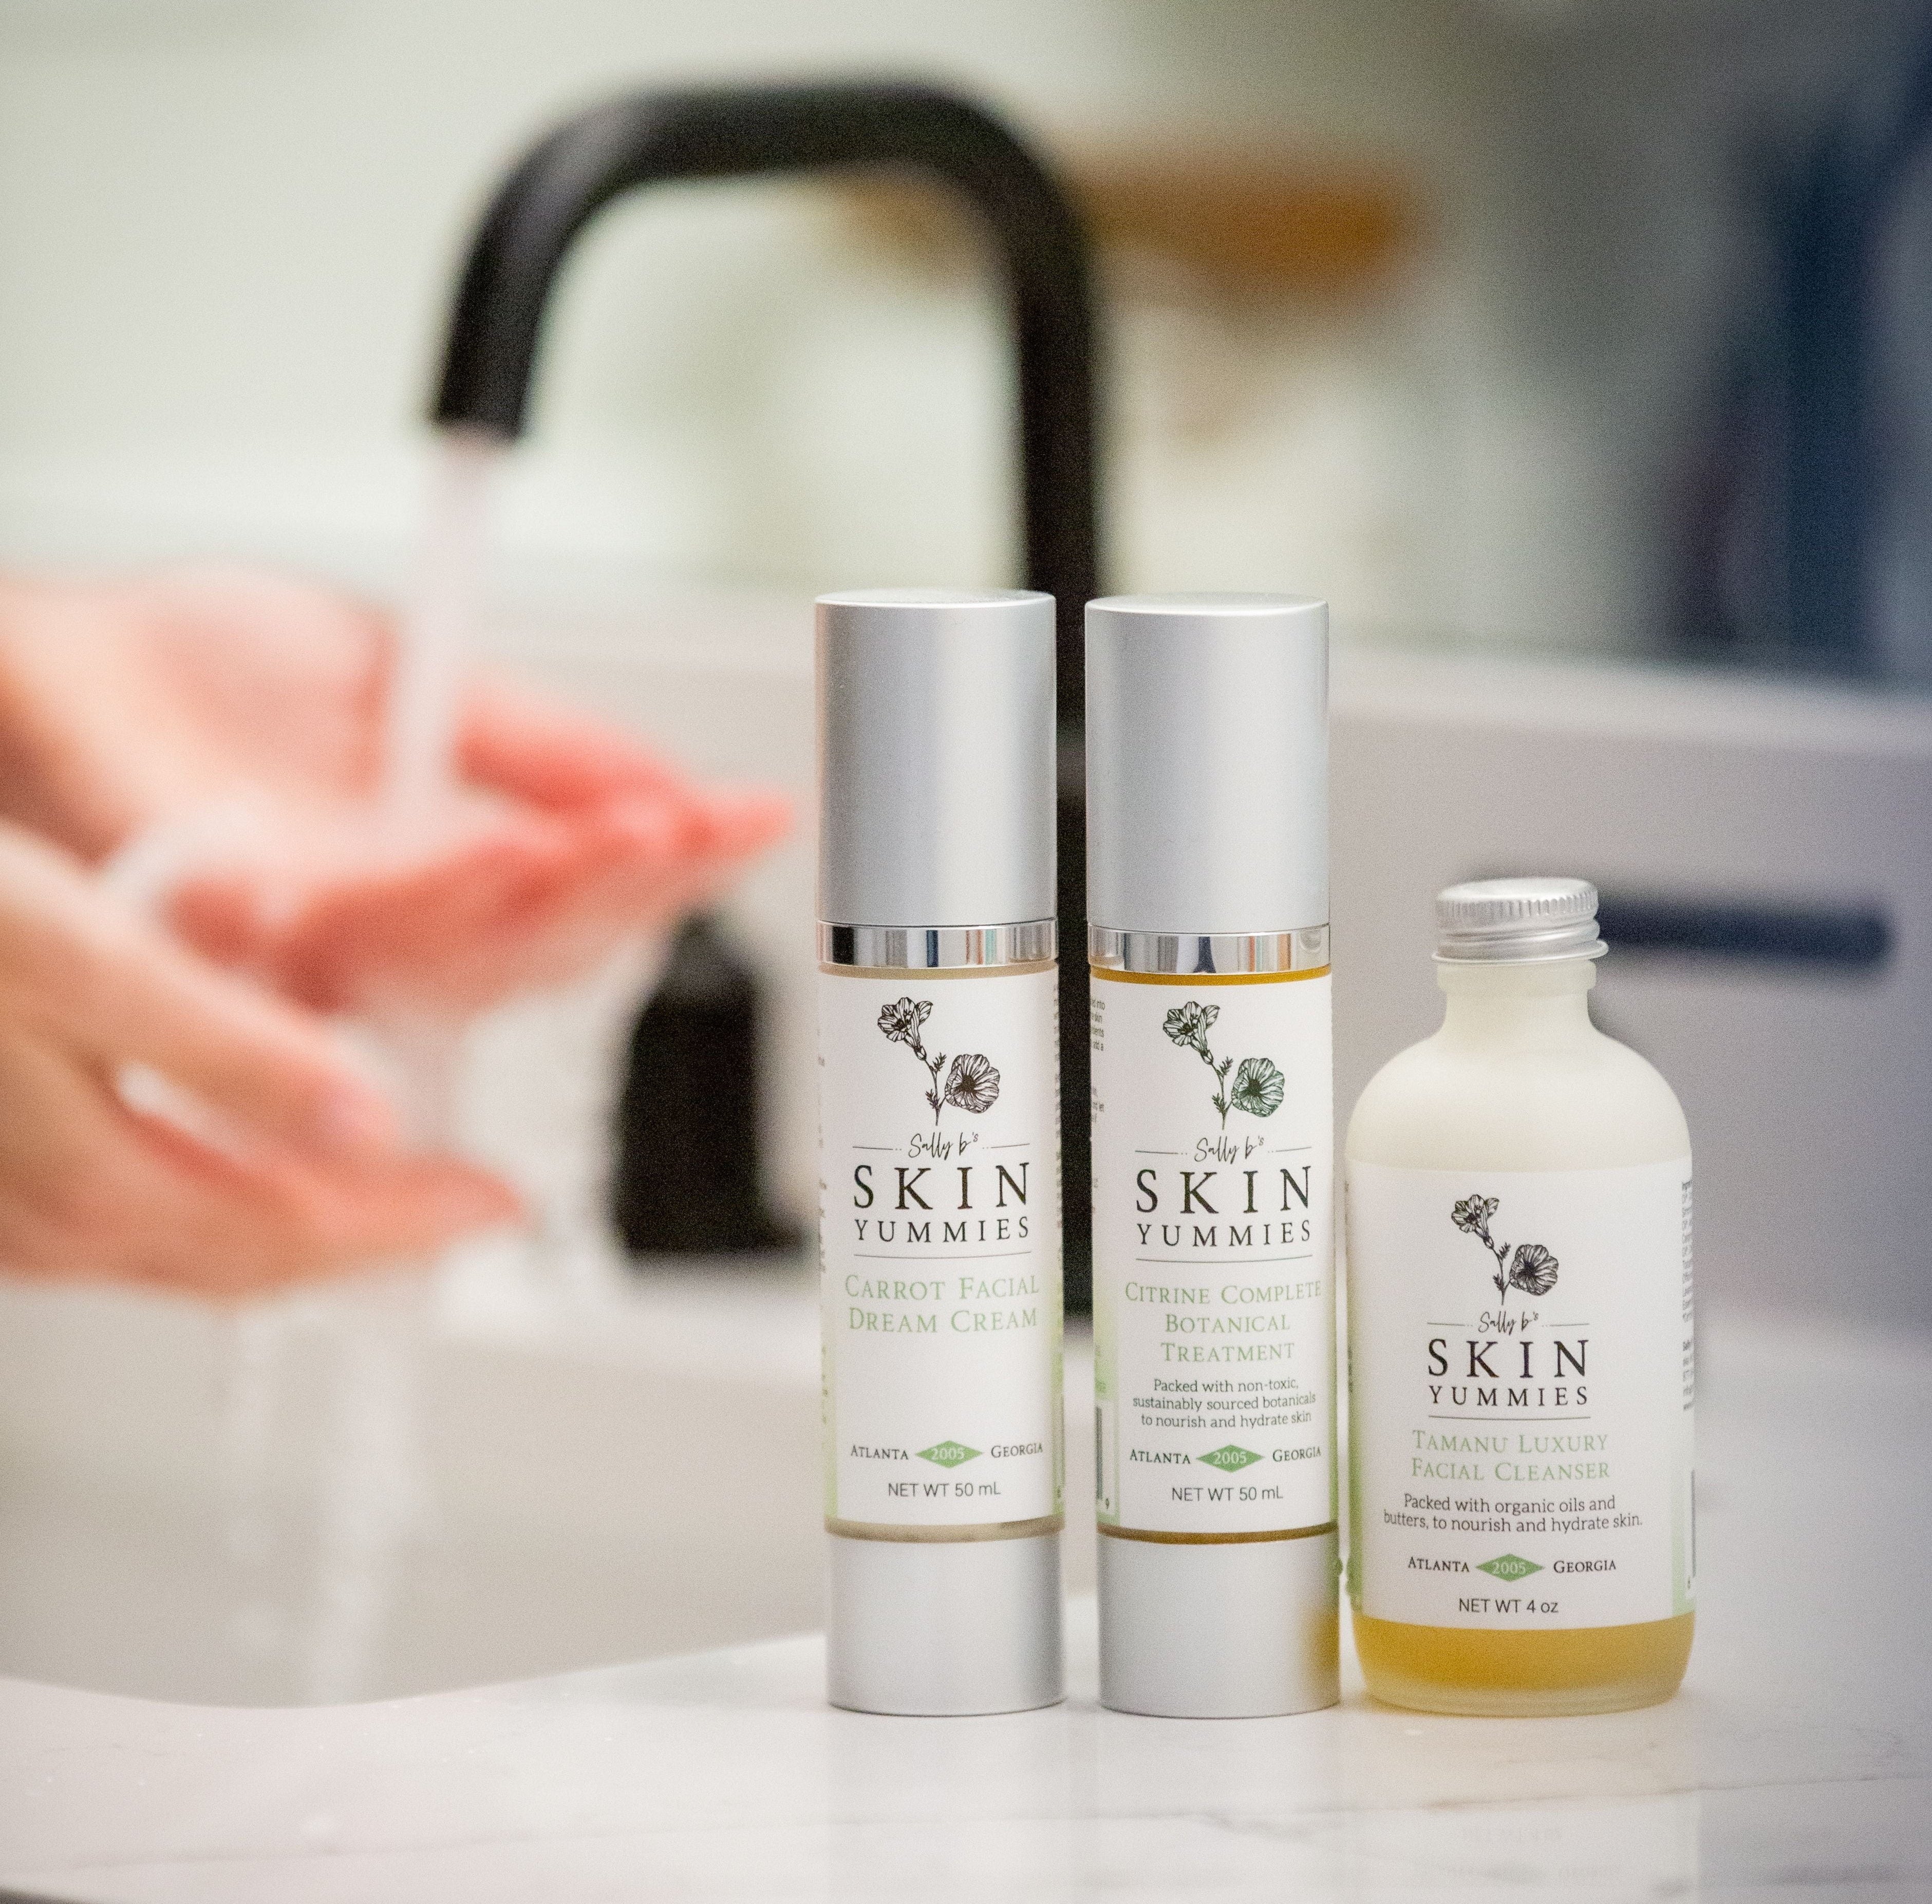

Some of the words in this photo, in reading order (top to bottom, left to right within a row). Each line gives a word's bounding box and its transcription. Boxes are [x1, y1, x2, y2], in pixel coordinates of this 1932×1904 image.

[908, 1132, 952, 1161] Sally
[1194, 1136, 1238, 1164] Sally
[854, 1162, 1029, 1210] SKIN
[1136, 1166, 1310, 1214] SKIN
[855, 1216, 1028, 1242] YUMMIES
[1137, 1220, 1309, 1247] YUMMIES
[1478, 1311, 1515, 1335] Sally
[1429, 1338, 1588, 1378] SKIN
[1154, 1378, 1198, 1392] Packed
[1202, 1380, 1233, 1392] with
[1238, 1377, 1298, 1392] non-toxic,
[1133, 1397, 1202, 1412] sustainably
[1207, 1397, 1259, 1410] sourced
[1262, 1392, 1316, 1408] botanicals
[1429, 1386, 1587, 1406] YUMMIES
[1141, 1414, 1153, 1425] to
[1156, 1415, 1206, 1428] nourish
[1210, 1415, 1235, 1428] and
[1241, 1414, 1288, 1429] hydrate
[1291, 1411, 1310, 1423] skin
[931, 1446, 965, 1461] 2005
[1212, 1450, 1248, 1465] 2005
[888, 1483, 918, 1497] NET
[924, 1483, 948, 1497] WT
[955, 1482, 973, 1497] 50
[979, 1482, 1001, 1495] mL
[1172, 1487, 1202, 1501] NET
[1208, 1488, 1233, 1501] WT
[1240, 1487, 1257, 1501] 50
[1262, 1486, 1283, 1499] mL
[1404, 1493, 1450, 1510] Packed
[1455, 1498, 1490, 1513] with
[1495, 1500, 1554, 1516] organic
[1559, 1497, 1585, 1512] oils
[1589, 1495, 1615, 1510] and
[1384, 1509, 1429, 1529] butters,
[1433, 1516, 1447, 1529] to
[1451, 1518, 1511, 1532] nourish
[1516, 1518, 1546, 1532] and
[1551, 1517, 1609, 1534] hydrate
[1613, 1514, 1642, 1528] skin.
[1492, 1561, 1527, 1574] 2005
[1459, 1598, 1489, 1612] NET
[1495, 1599, 1521, 1613] WT
[1527, 1600, 1535, 1613] 4
[1541, 1602, 1558, 1613] oz
